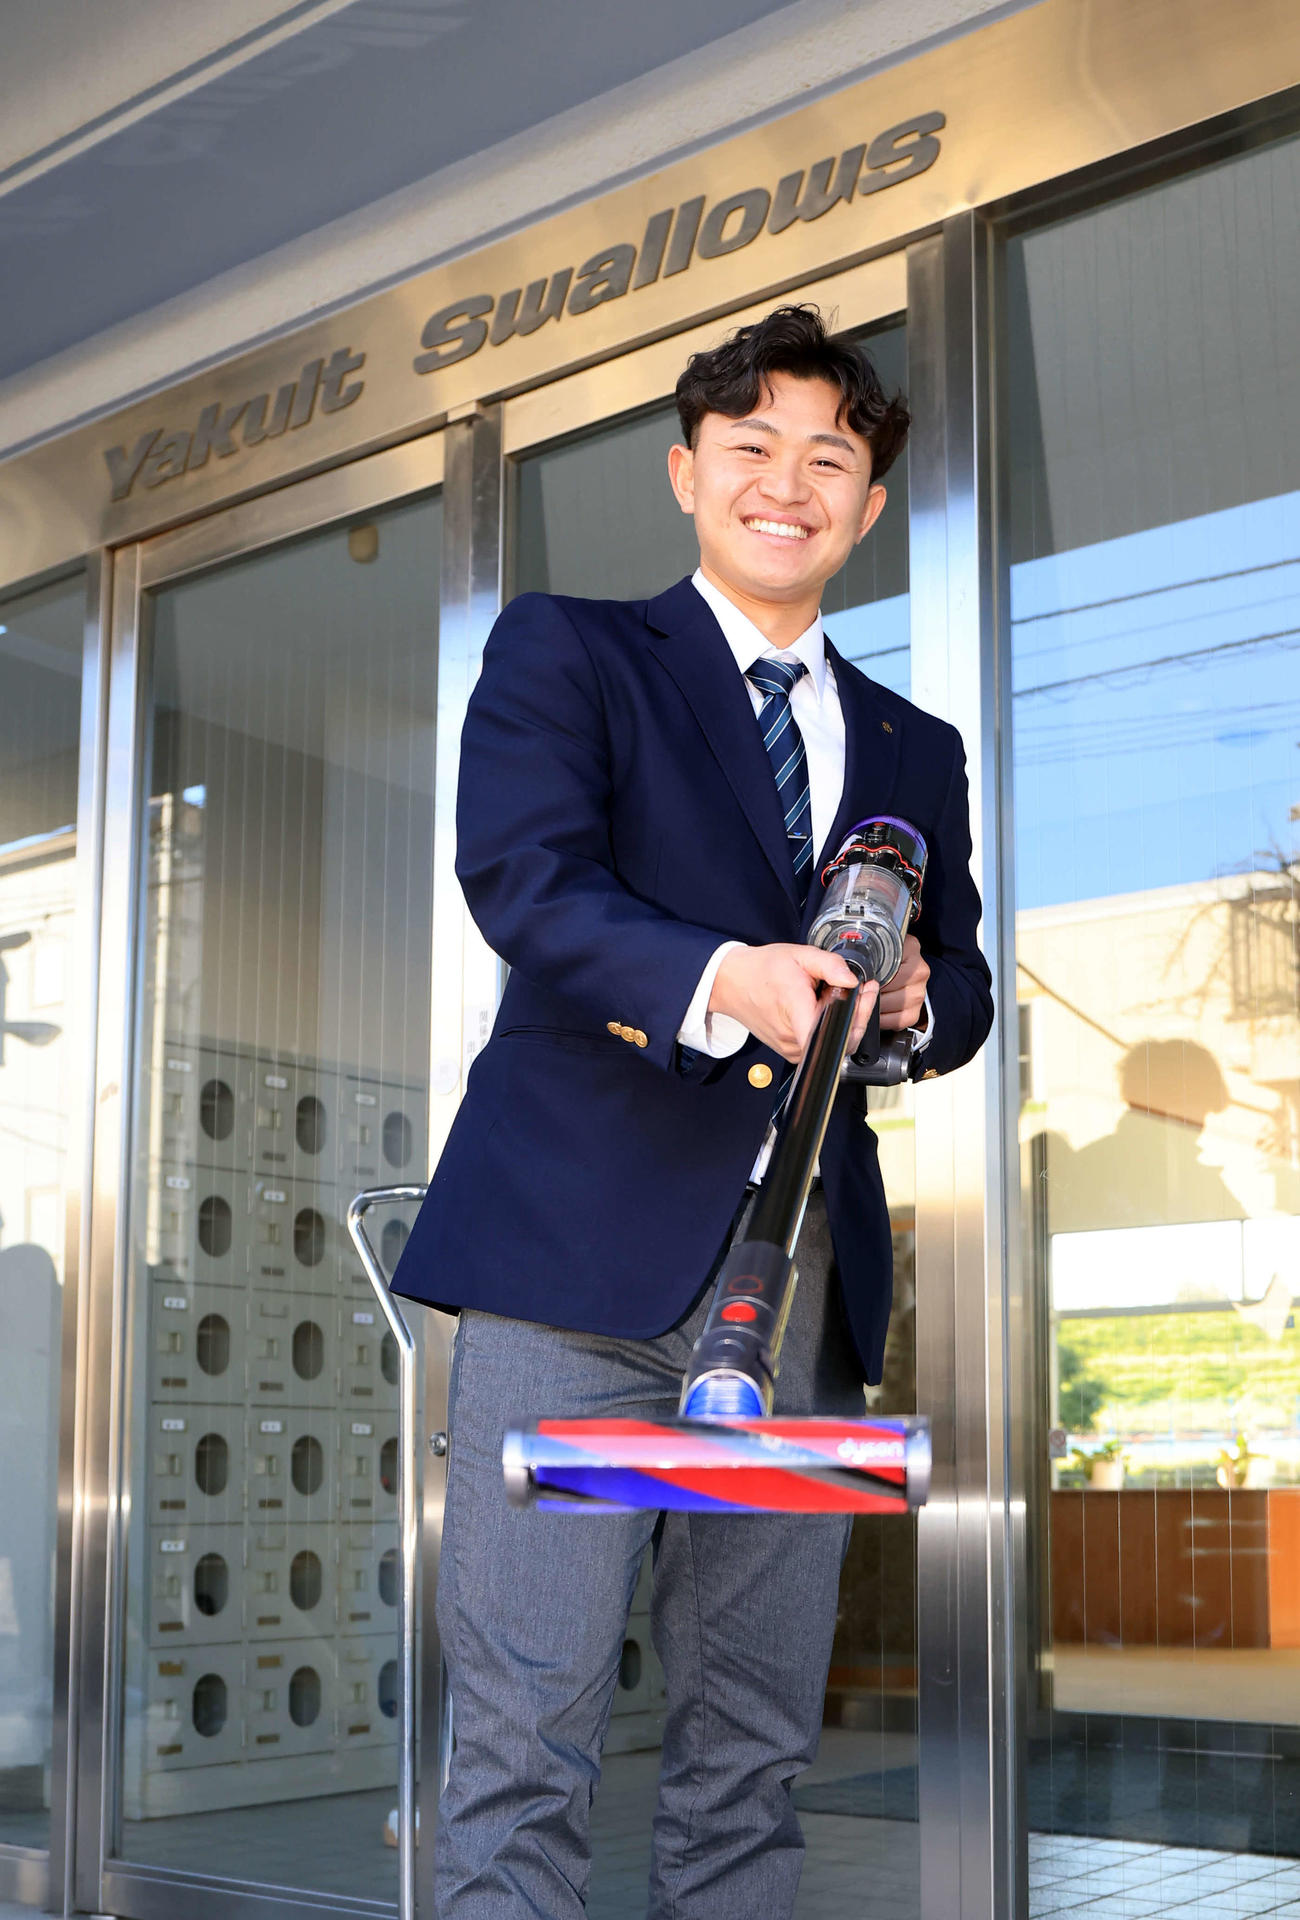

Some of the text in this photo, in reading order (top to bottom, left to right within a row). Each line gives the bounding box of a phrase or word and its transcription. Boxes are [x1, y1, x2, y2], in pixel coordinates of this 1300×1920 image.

[103, 111, 947, 502] Yakult Swallows
[837, 1437, 904, 1464] dyson
